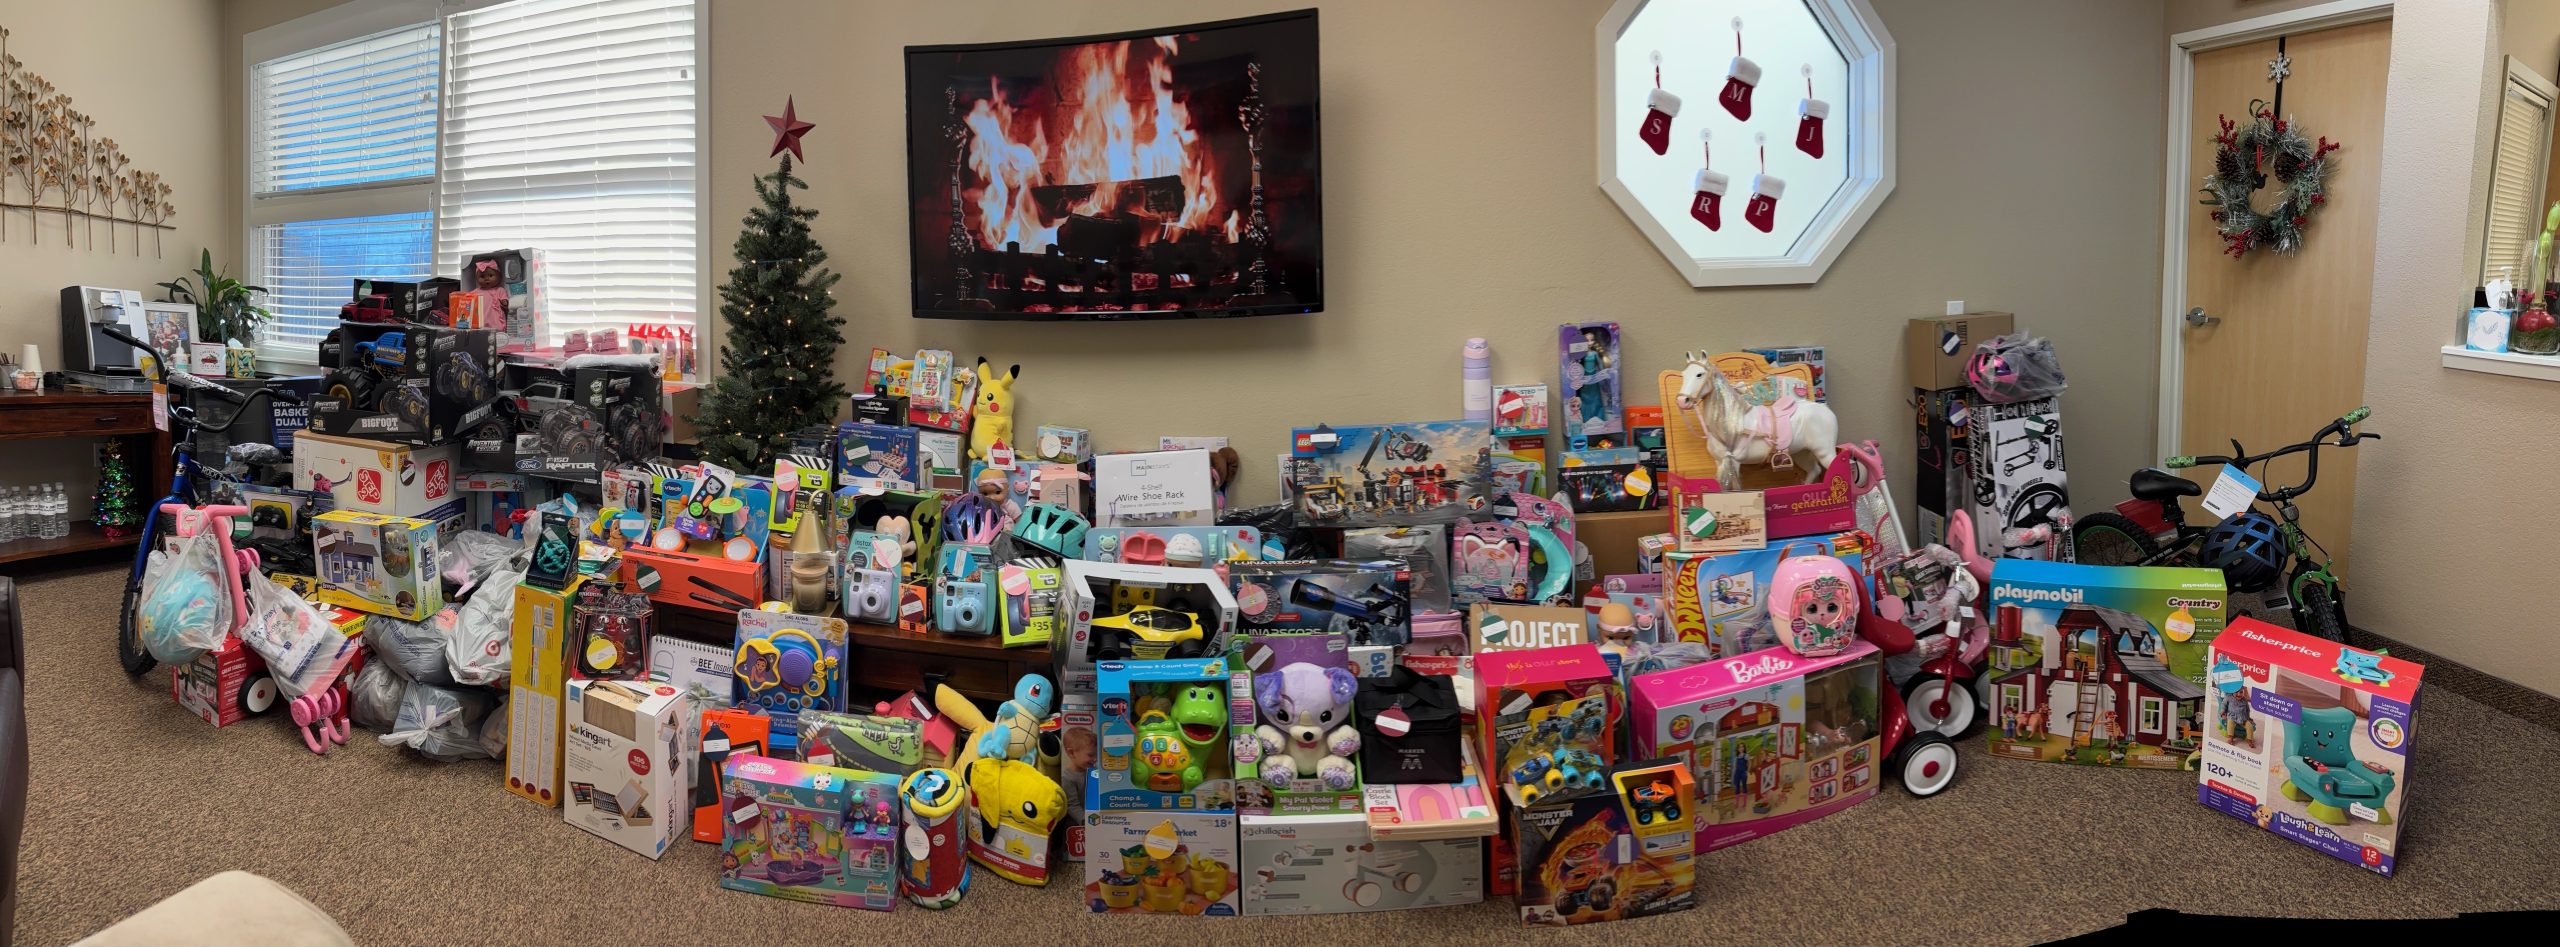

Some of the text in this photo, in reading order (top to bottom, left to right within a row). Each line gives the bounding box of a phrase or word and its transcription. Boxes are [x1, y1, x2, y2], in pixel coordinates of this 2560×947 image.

[1728, 83, 1747, 103] M
[1650, 118, 1662, 135] S
[1806, 126, 1815, 142] J
[1698, 196, 1712, 214] R
[1756, 200, 1770, 217] P
[465, 404, 492, 424] BIGFOOT
[275, 418, 302, 428] DUAL
[362, 417, 398, 428] BIGFOOT
[521, 460, 538, 470] Ford
[546, 462, 598, 472] RAPTOR
[359, 470, 381, 500] STEP
[426, 463, 448, 497] STEP
[358, 490, 366, 500] 2
[440, 483, 448, 495] 2
[1118, 490, 1184, 502] Wire Shoe Rack
[1802, 490, 1828, 502] our
[1791, 496, 1848, 512] generation
[1993, 584, 2084, 603] playmobil
[2168, 598, 2221, 610] Country
[742, 618, 768, 628] Rachel
[2241, 630, 2322, 658] fisher-price
[698, 658, 734, 672] BEE Inspir
[1726, 658, 1793, 682] Barbie
[2263, 700, 2280, 709] stand
[2269, 694, 2286, 706] down
[1497, 725, 1532, 738] MONSTER
[1507, 732, 1524, 742] JAM
[2208, 741, 2230, 754] Remote
[2248, 756, 2263, 766] book
[633, 756, 646, 765] 105
[2206, 762, 2233, 778] 120+
[1523, 808, 1574, 821] MONSTER
[1214, 819, 1232, 828] 18+
[1536, 816, 1561, 827] JAM
[2280, 826, 2298, 837] Smart
[2322, 842, 2340, 853] Chair
[2365, 849, 2377, 859] 12
